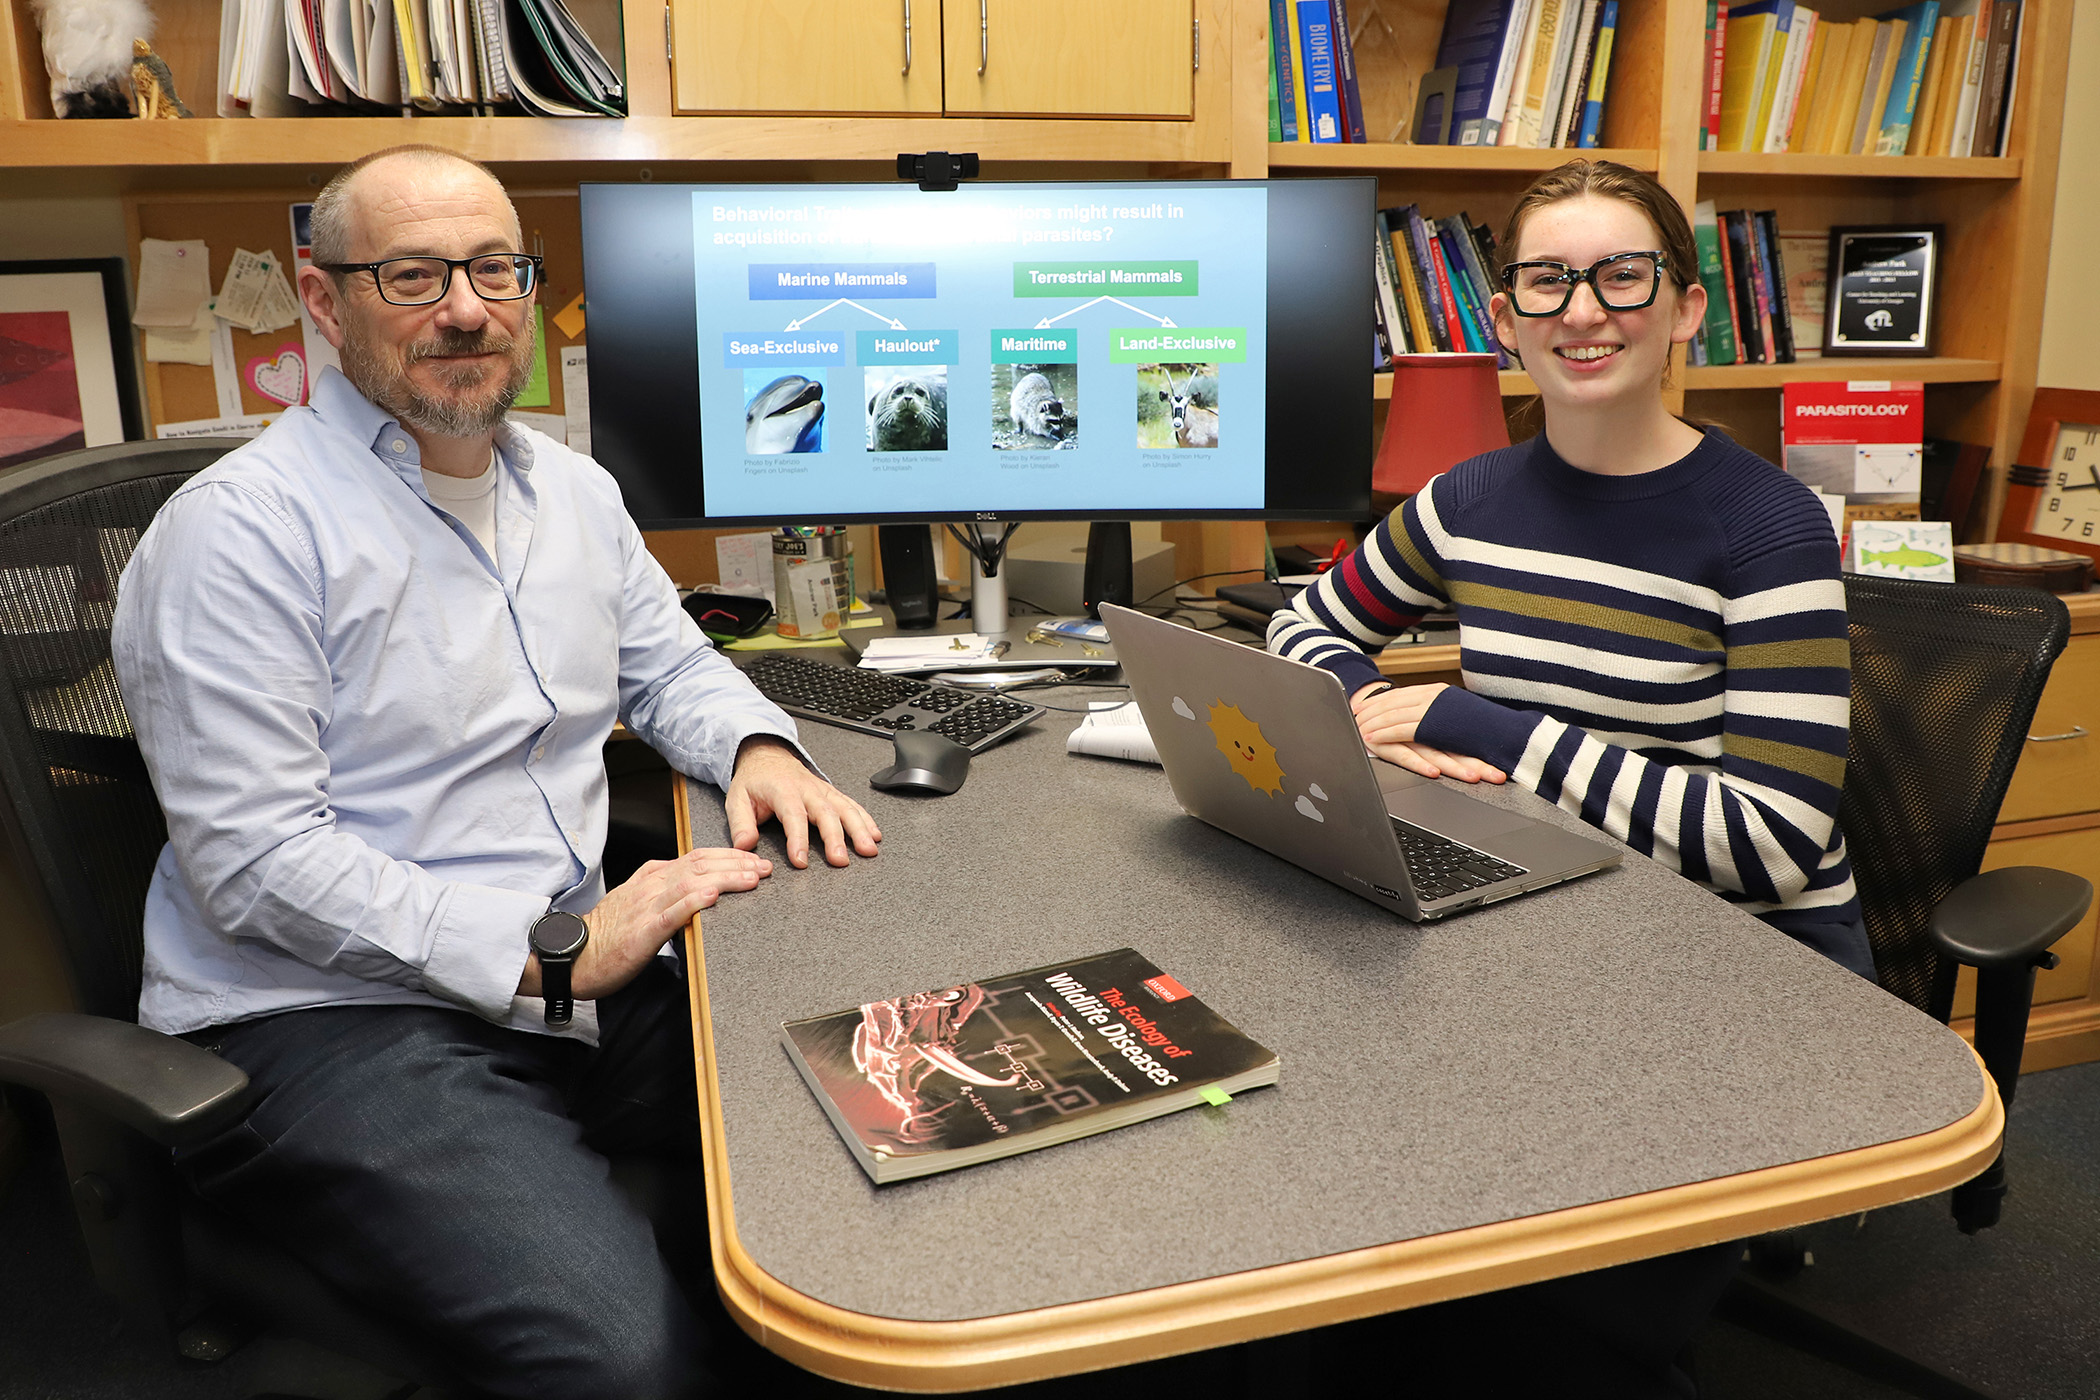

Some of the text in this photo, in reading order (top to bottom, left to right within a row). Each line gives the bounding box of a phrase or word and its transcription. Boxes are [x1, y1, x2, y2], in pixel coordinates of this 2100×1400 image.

[1309, 24, 1332, 84] BIOMETRY
[1281, 55, 1293, 103] GENETICS
[712, 206, 808, 222] Behavioral
[1057, 204, 1107, 222] might
[1112, 203, 1163, 219] result
[1168, 203, 1184, 219] in
[713, 229, 812, 248] acquisition
[1022, 226, 1114, 246] parasites?
[778, 272, 908, 286] Marine Mammals
[1029, 269, 1183, 284] Terrestrial Mammals
[729, 340, 839, 355] Sea-Exclusive
[1001, 337, 1067, 351] Maritime
[1119, 336, 1236, 350] Land-Exclusive
[1796, 404, 1909, 417] PARASITOLOGY
[2085, 432, 2097, 445] 11
[1163, 453, 1171, 461] by
[2064, 447, 2077, 461] 10
[2056, 472, 2068, 486] 9
[2049, 498, 2061, 512] 8
[976, 512, 997, 520] DELL
[2062, 518, 2074, 532] 7
[2082, 522, 2095, 536] 6
[1148, 979, 1176, 1001] OXFORD
[1045, 972, 1179, 1087] Wildlife Diseases
[1100, 987, 1193, 1059] The Ecology of
